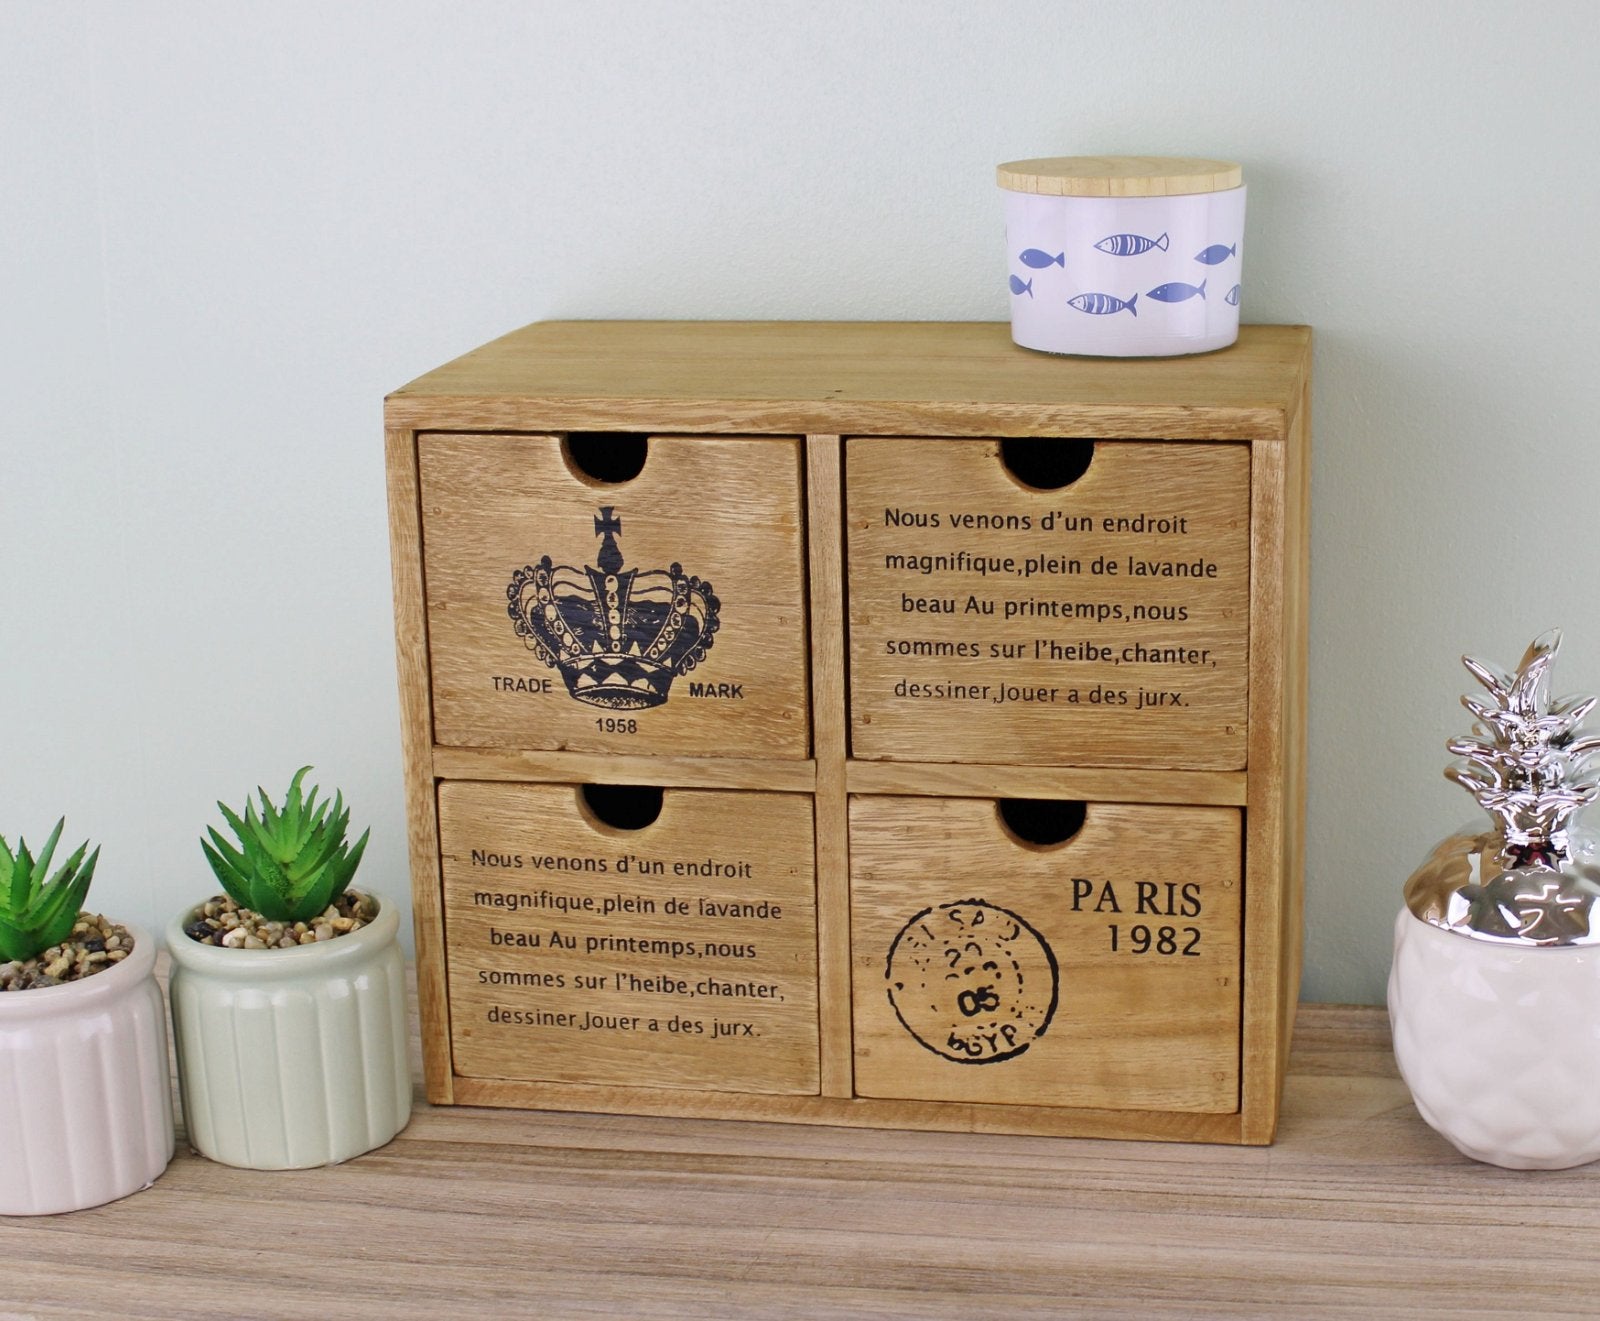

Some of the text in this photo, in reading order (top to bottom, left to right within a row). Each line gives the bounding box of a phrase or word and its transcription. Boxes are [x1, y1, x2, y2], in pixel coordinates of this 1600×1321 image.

[885, 508, 1188, 535] Nous venons d'un endroit
[1091, 555, 1118, 576] de
[1128, 556, 1218, 578] lavande
[901, 592, 955, 614] beau
[964, 595, 994, 615] Au
[886, 640, 980, 658] sommes
[990, 643, 1026, 659] sur
[492, 676, 744, 699] TRADE MARK
[1067, 689, 1080, 704] a
[1088, 684, 1128, 705] des
[595, 717, 638, 735] 1958
[471, 849, 752, 879] Nous venons d'un endroit
[664, 897, 689, 916] de
[699, 898, 782, 920] lavande
[490, 927, 540, 947] beau
[549, 931, 577, 949] Au
[1108, 924, 1201, 957] 1982
[478, 970, 565, 988] sommes
[574, 975, 608, 990] sur
[648, 1018, 659, 1032] a
[667, 1015, 704, 1034] des
